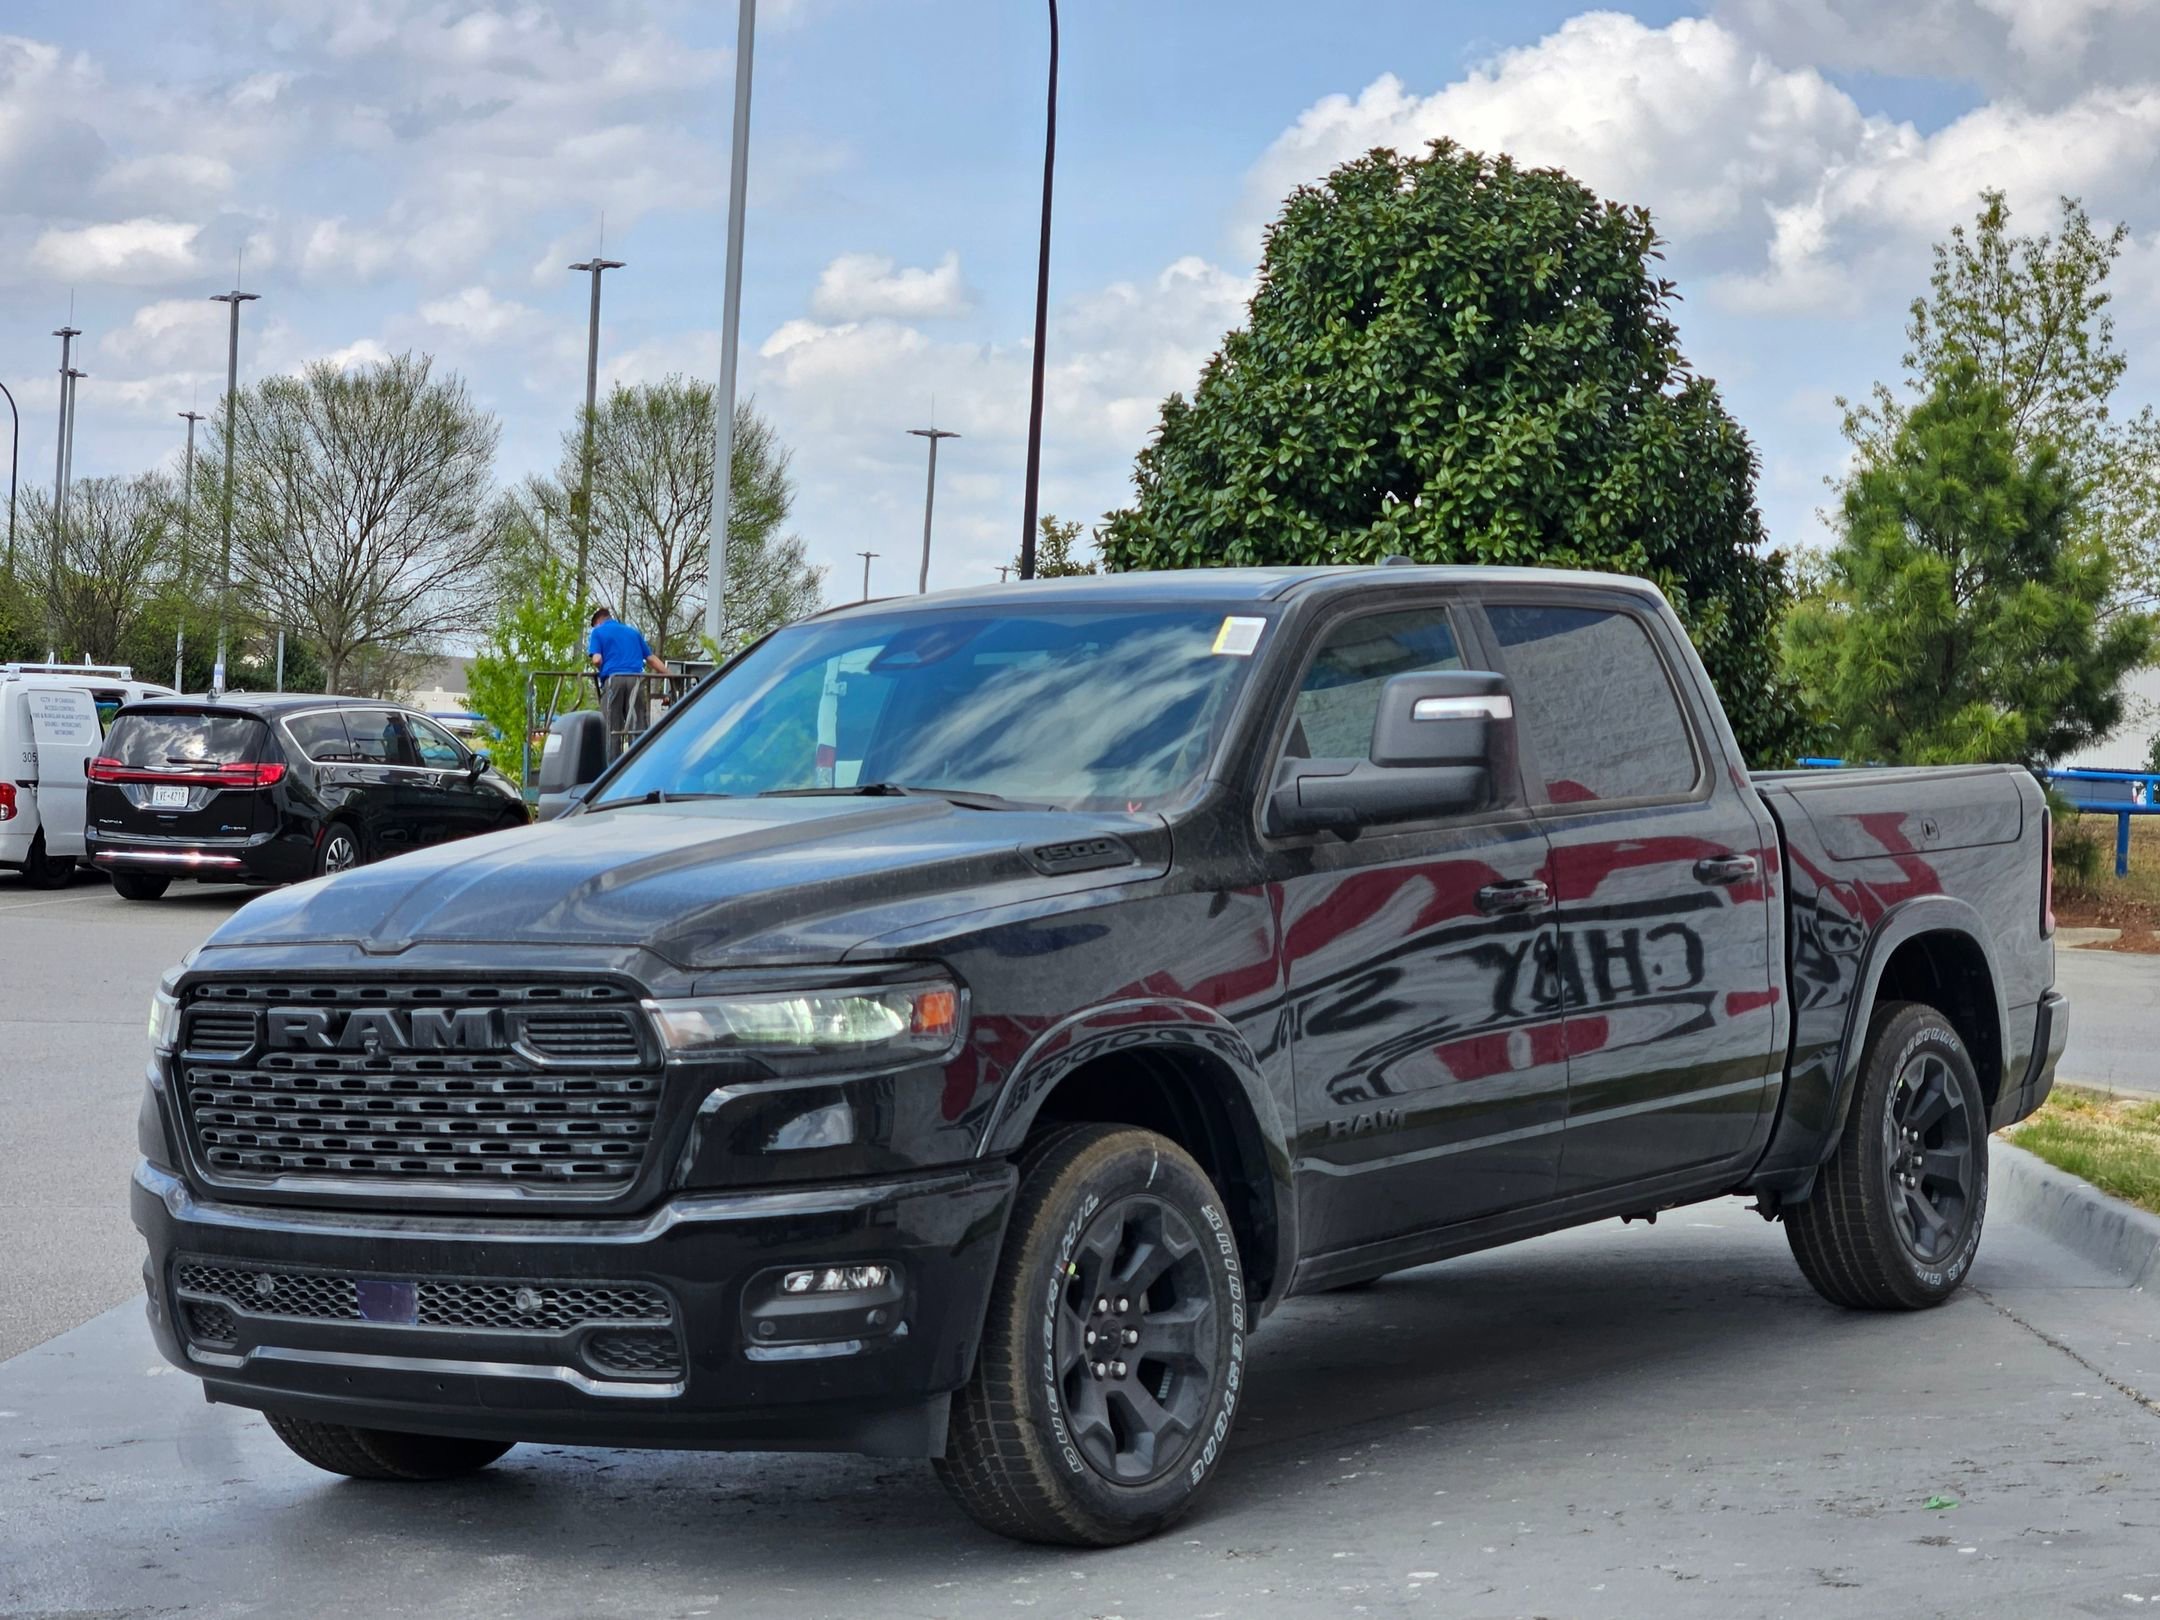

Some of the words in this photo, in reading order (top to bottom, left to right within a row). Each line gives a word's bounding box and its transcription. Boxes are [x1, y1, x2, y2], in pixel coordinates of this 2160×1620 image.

[1037, 840, 1114, 861] 1500
[267, 1006, 504, 1050] RAM
[1326, 1108, 1406, 1138] RAM
[1190, 1203, 1245, 1487] BRIDGESTONE
[1043, 1277, 1084, 1474] DUELER
